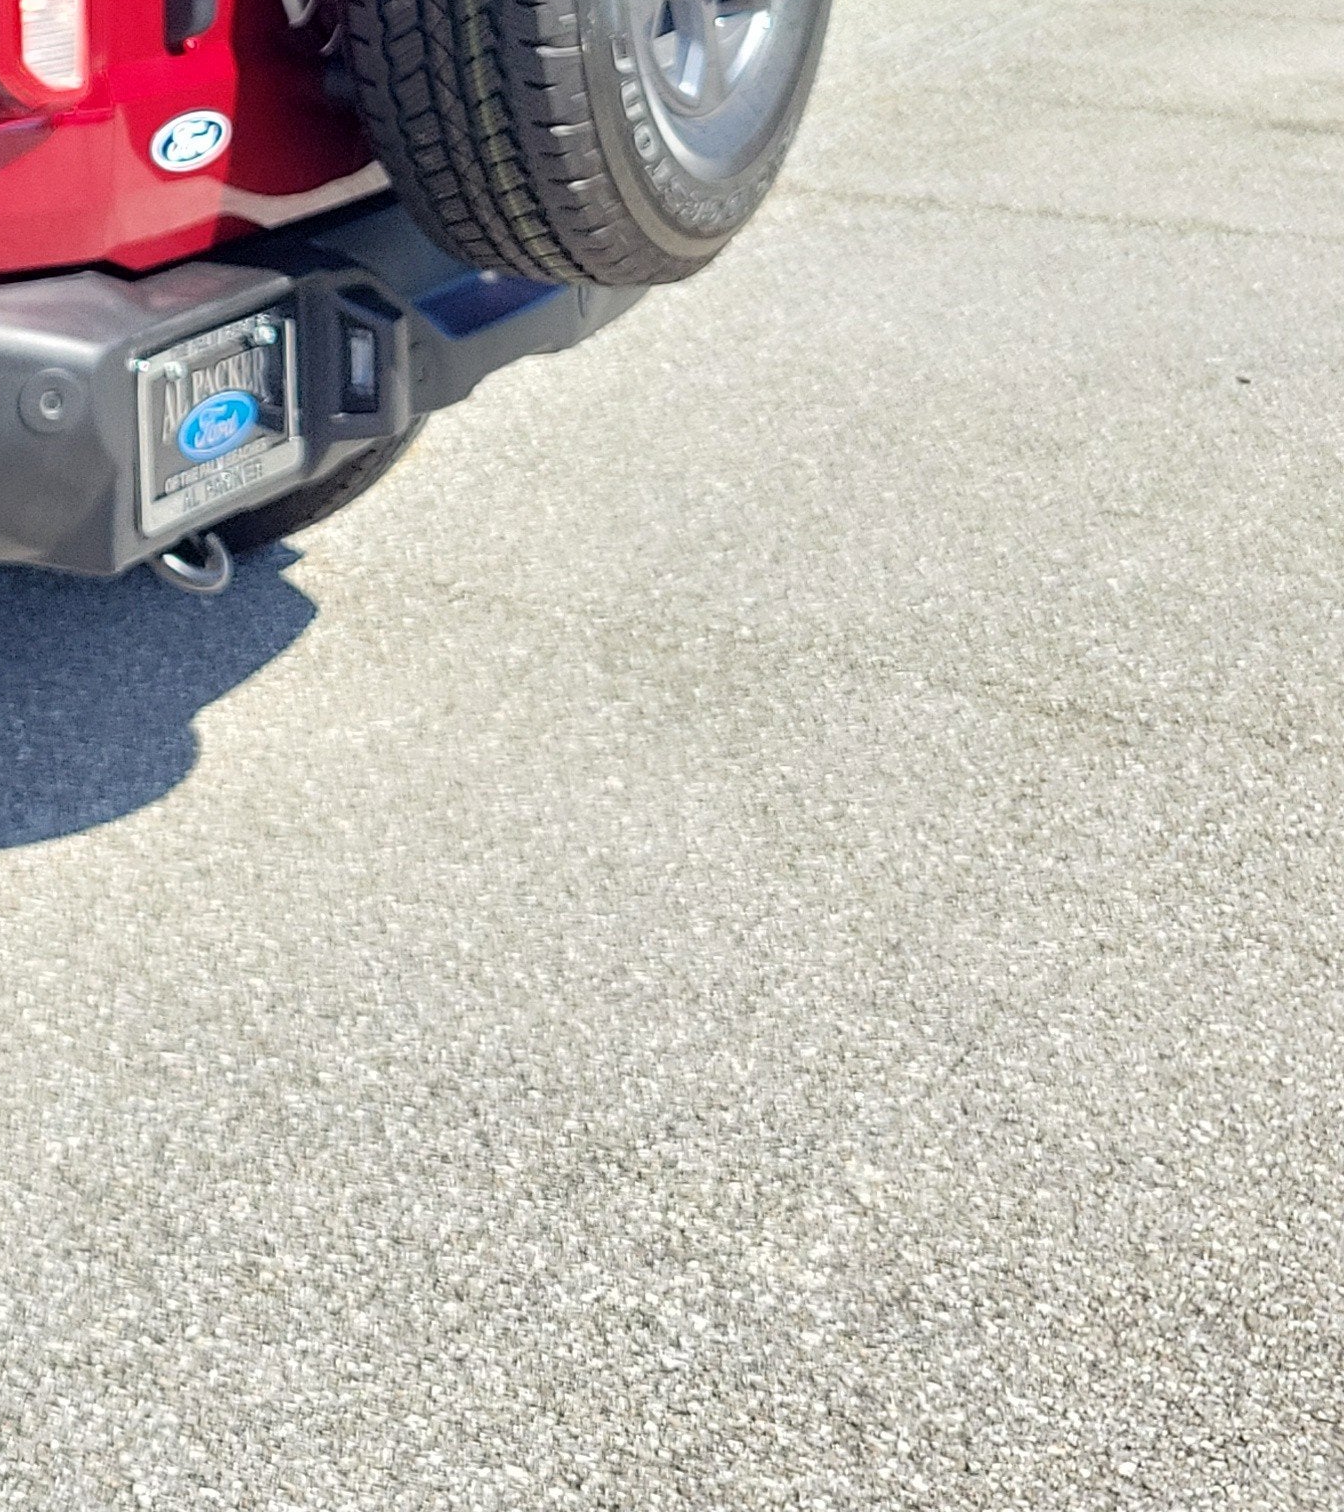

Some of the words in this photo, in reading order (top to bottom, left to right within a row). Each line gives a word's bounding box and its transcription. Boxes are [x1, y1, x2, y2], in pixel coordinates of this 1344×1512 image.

[160, 374, 194, 445] AL
[190, 346, 275, 404] PACKER
[193, 404, 240, 449] Ford
